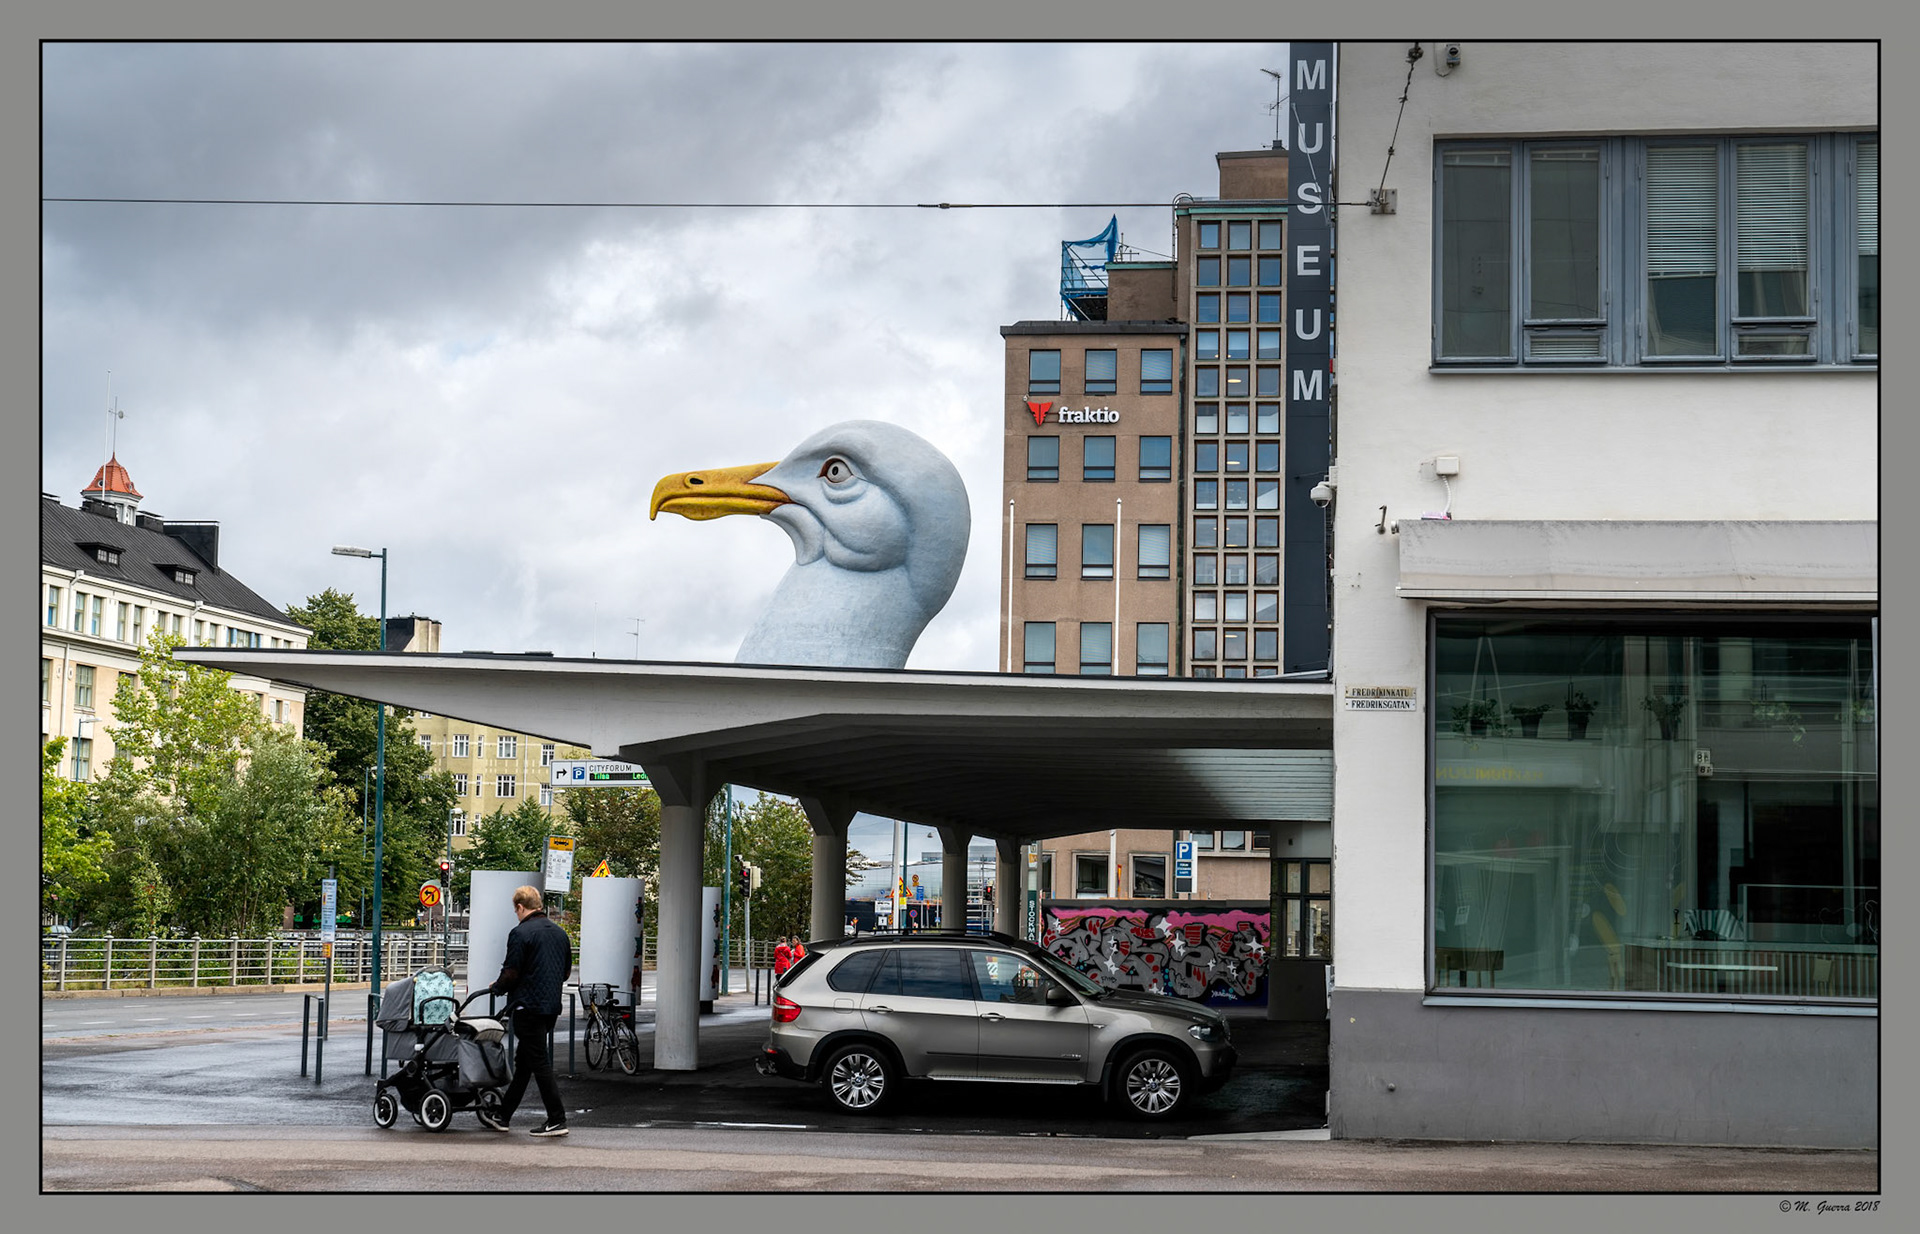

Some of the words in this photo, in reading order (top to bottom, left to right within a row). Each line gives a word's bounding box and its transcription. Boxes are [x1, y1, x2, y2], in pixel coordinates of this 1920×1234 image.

[1293, 59, 1326, 400] MUSEUM
[1058, 406, 1120, 423] fraktio
[1352, 688, 1409, 697] FREDRIKINKATU
[1351, 700, 1410, 709] FREDRIKSGATAN
[1179, 843, 1189, 859] P
